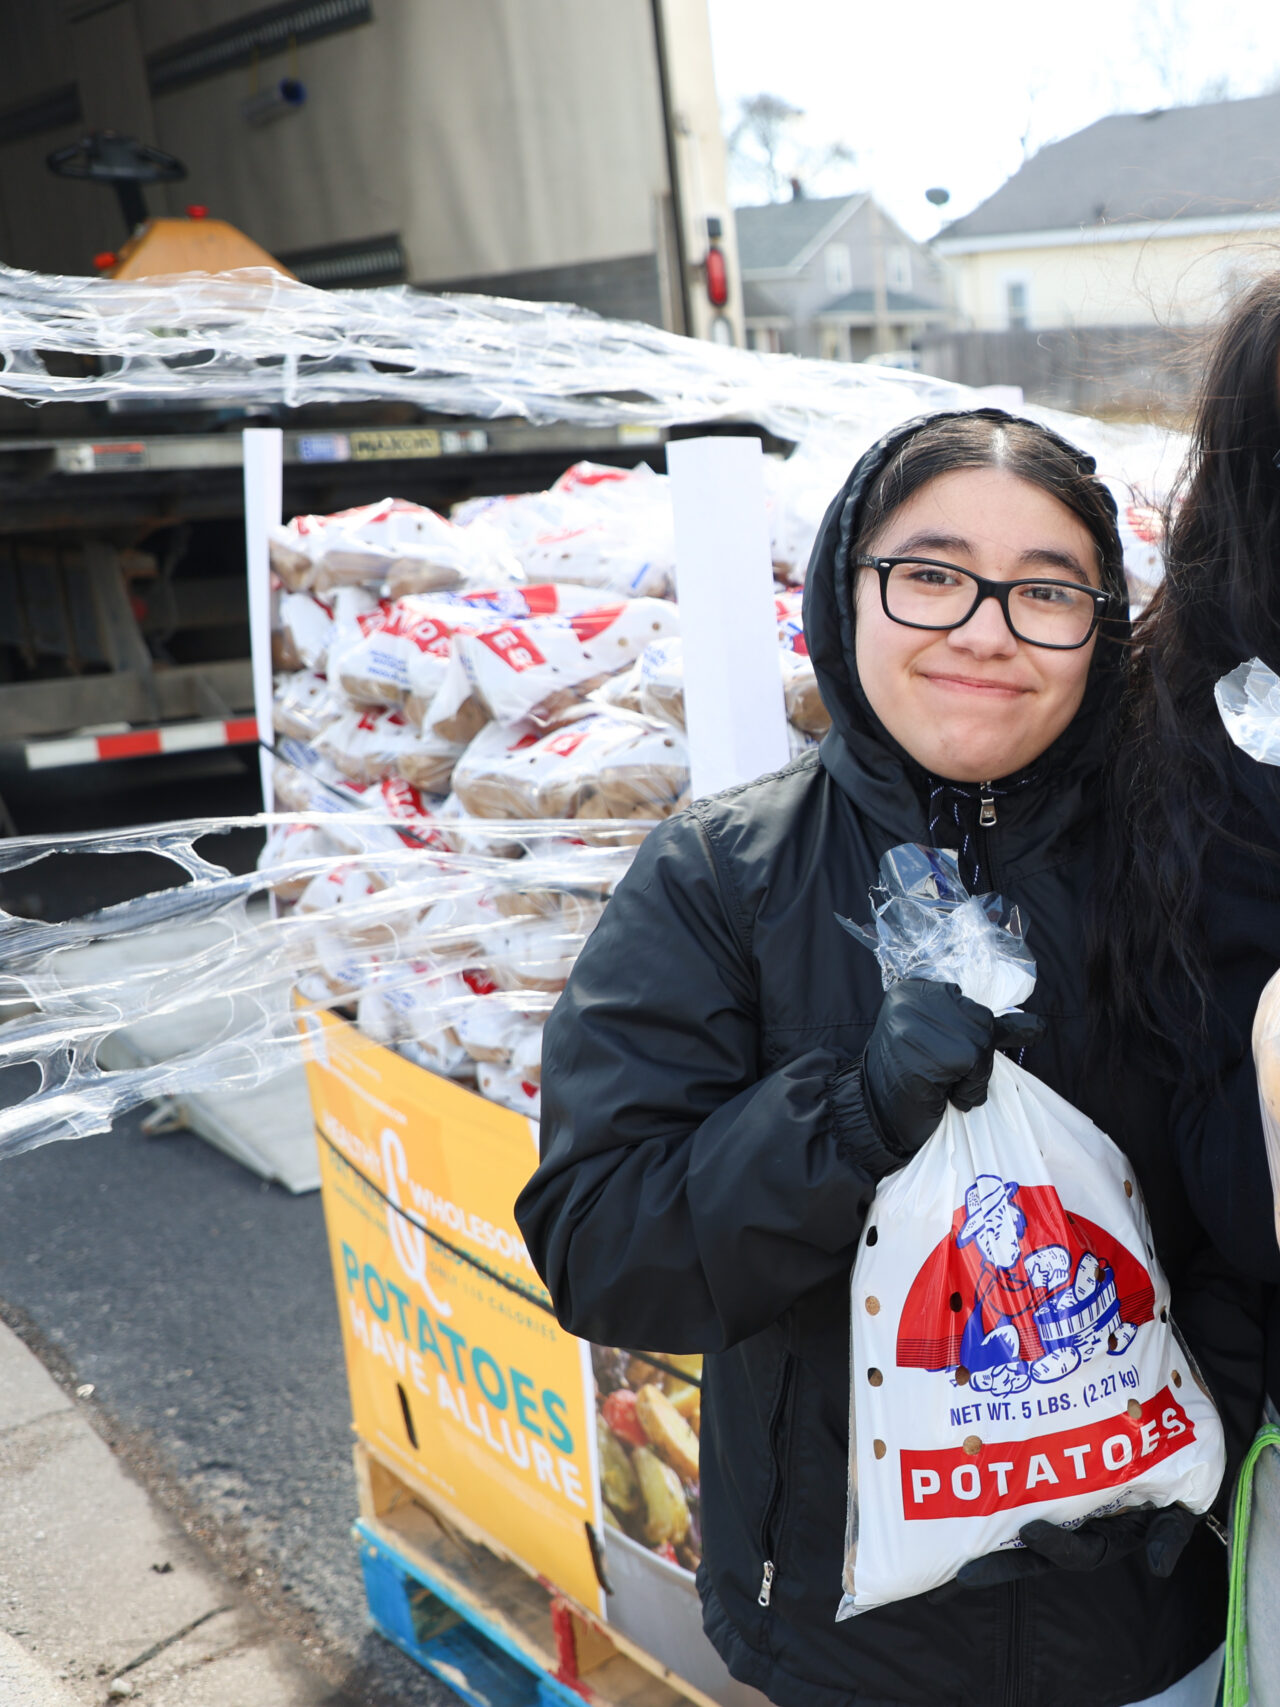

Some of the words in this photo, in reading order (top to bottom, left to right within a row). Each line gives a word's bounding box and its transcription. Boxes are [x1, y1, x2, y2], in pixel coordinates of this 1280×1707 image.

[409, 1177, 534, 1272] WHOLESOM
[341, 1239, 574, 1455] POTATOES
[950, 1403, 982, 1427] NET
[987, 1402, 1016, 1422] WT.
[1021, 1401, 1032, 1419] 5
[1037, 1393, 1077, 1417] LBS.
[1083, 1378, 1117, 1408] (2.27
[1118, 1364, 1140, 1388] kg)
[349, 1298, 431, 1396] HAVE
[437, 1372, 588, 1508] ALLURE
[910, 1407, 1187, 1504] POTATOES
